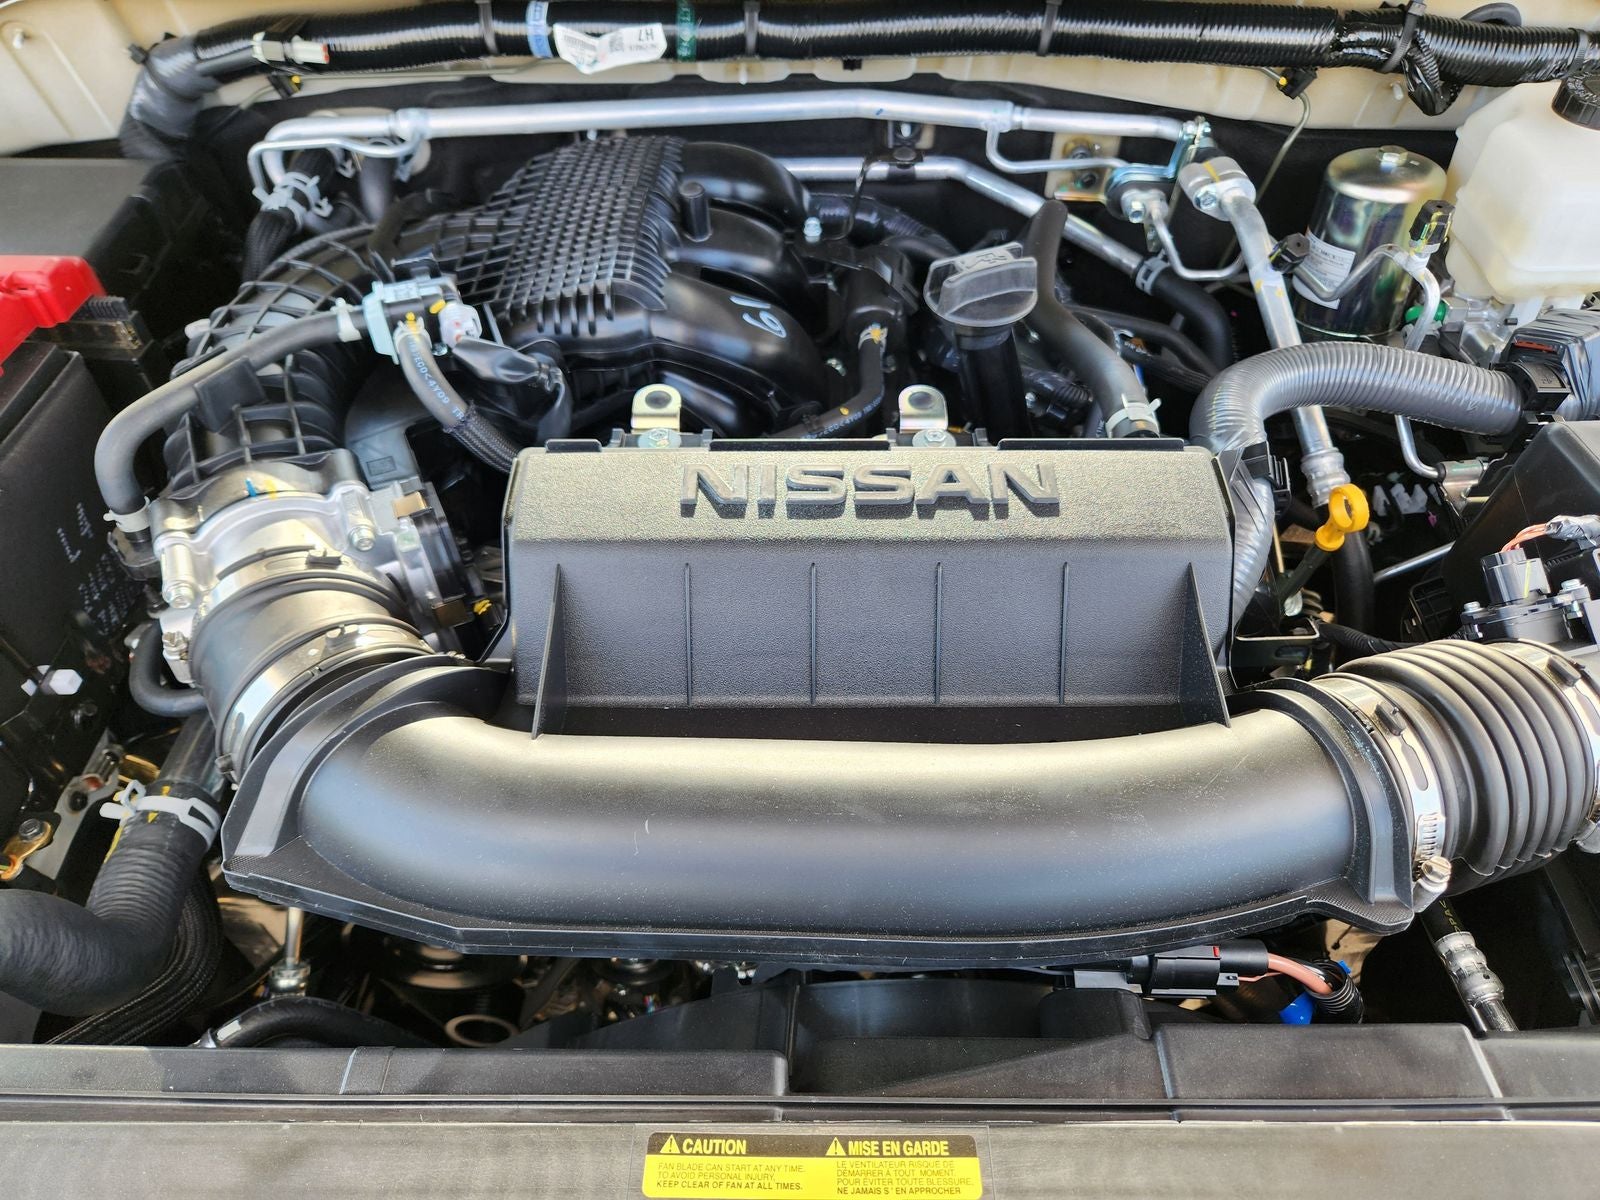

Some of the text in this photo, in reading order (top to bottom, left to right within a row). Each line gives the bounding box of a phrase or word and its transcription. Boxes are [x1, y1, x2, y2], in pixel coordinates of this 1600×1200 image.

[680, 463, 1060, 505] NISSAN
[683, 1138, 746, 1154] CAUTION
[849, 1141, 949, 1156] MISE EN GARDE
[658, 1162, 674, 1170] FAN
[677, 1163, 703, 1171] BLADE
[706, 1163, 723, 1171] CAN
[726, 1164, 751, 1172] START
[753, 1164, 763, 1172] AT
[837, 1161, 846, 1169] LE
[849, 1161, 906, 1169] VENTILATEUR
[909, 1161, 940, 1169] RISQUE
[658, 1171, 669, 1179] TO
[698, 1172, 742, 1180] PERSONAL
[893, 1169, 915, 1177] TOUT
[682, 1181, 710, 1189] CLEAR
[712, 1181, 723, 1189] OF
[726, 1181, 742, 1189] FAN
[757, 1182, 773, 1190] ALL
[776, 1182, 803, 1190] TIMES.
[837, 1178, 860, 1186] POUR
[896, 1178, 924, 1186] TOUTE
[837, 1187, 849, 1195] NE
[851, 1187, 881, 1195] JAMAIS
[896, 1187, 906, 1195] EN
[909, 1187, 961, 1195] APPROCHER
